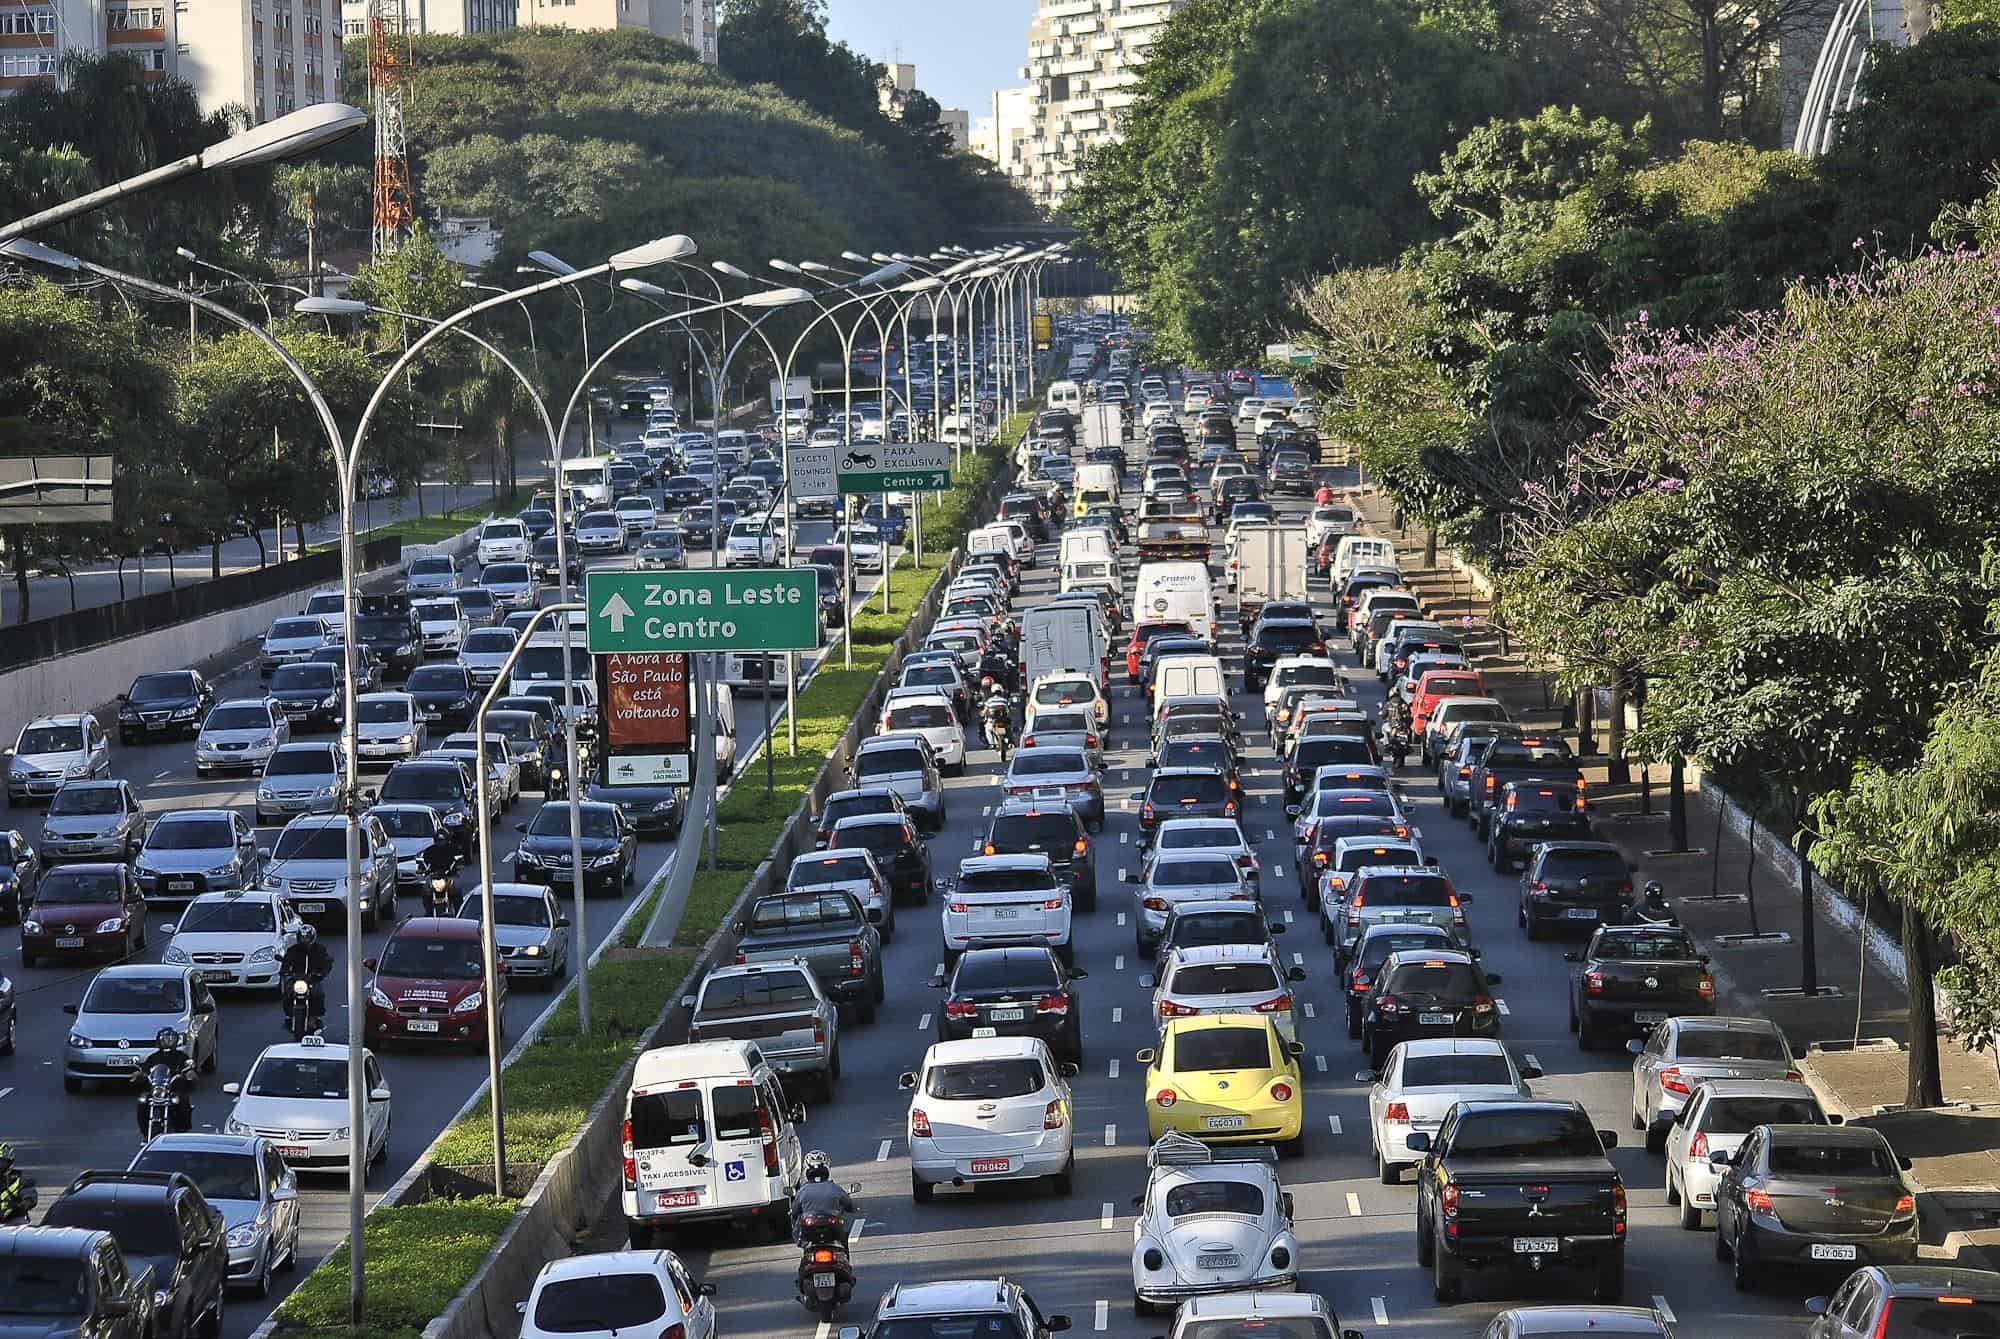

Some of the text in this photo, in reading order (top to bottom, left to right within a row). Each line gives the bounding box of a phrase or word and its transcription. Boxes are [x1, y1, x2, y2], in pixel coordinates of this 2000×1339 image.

[883, 447, 917, 456] FAIXA
[795, 455, 828, 463] EXCETO
[884, 458, 943, 468] EXCLUSIVA
[794, 468, 832, 476] DOMINGO
[883, 476, 924, 487] Centro
[644, 583, 801, 606] Zona Leste
[644, 616, 737, 639] Centro
[610, 653, 683, 665] A hora de
[611, 668, 682, 684] São Paulo
[632, 686, 662, 701] está
[616, 703, 680, 719] voltando
[663, 1169, 708, 1178] ACESSÍVEL
